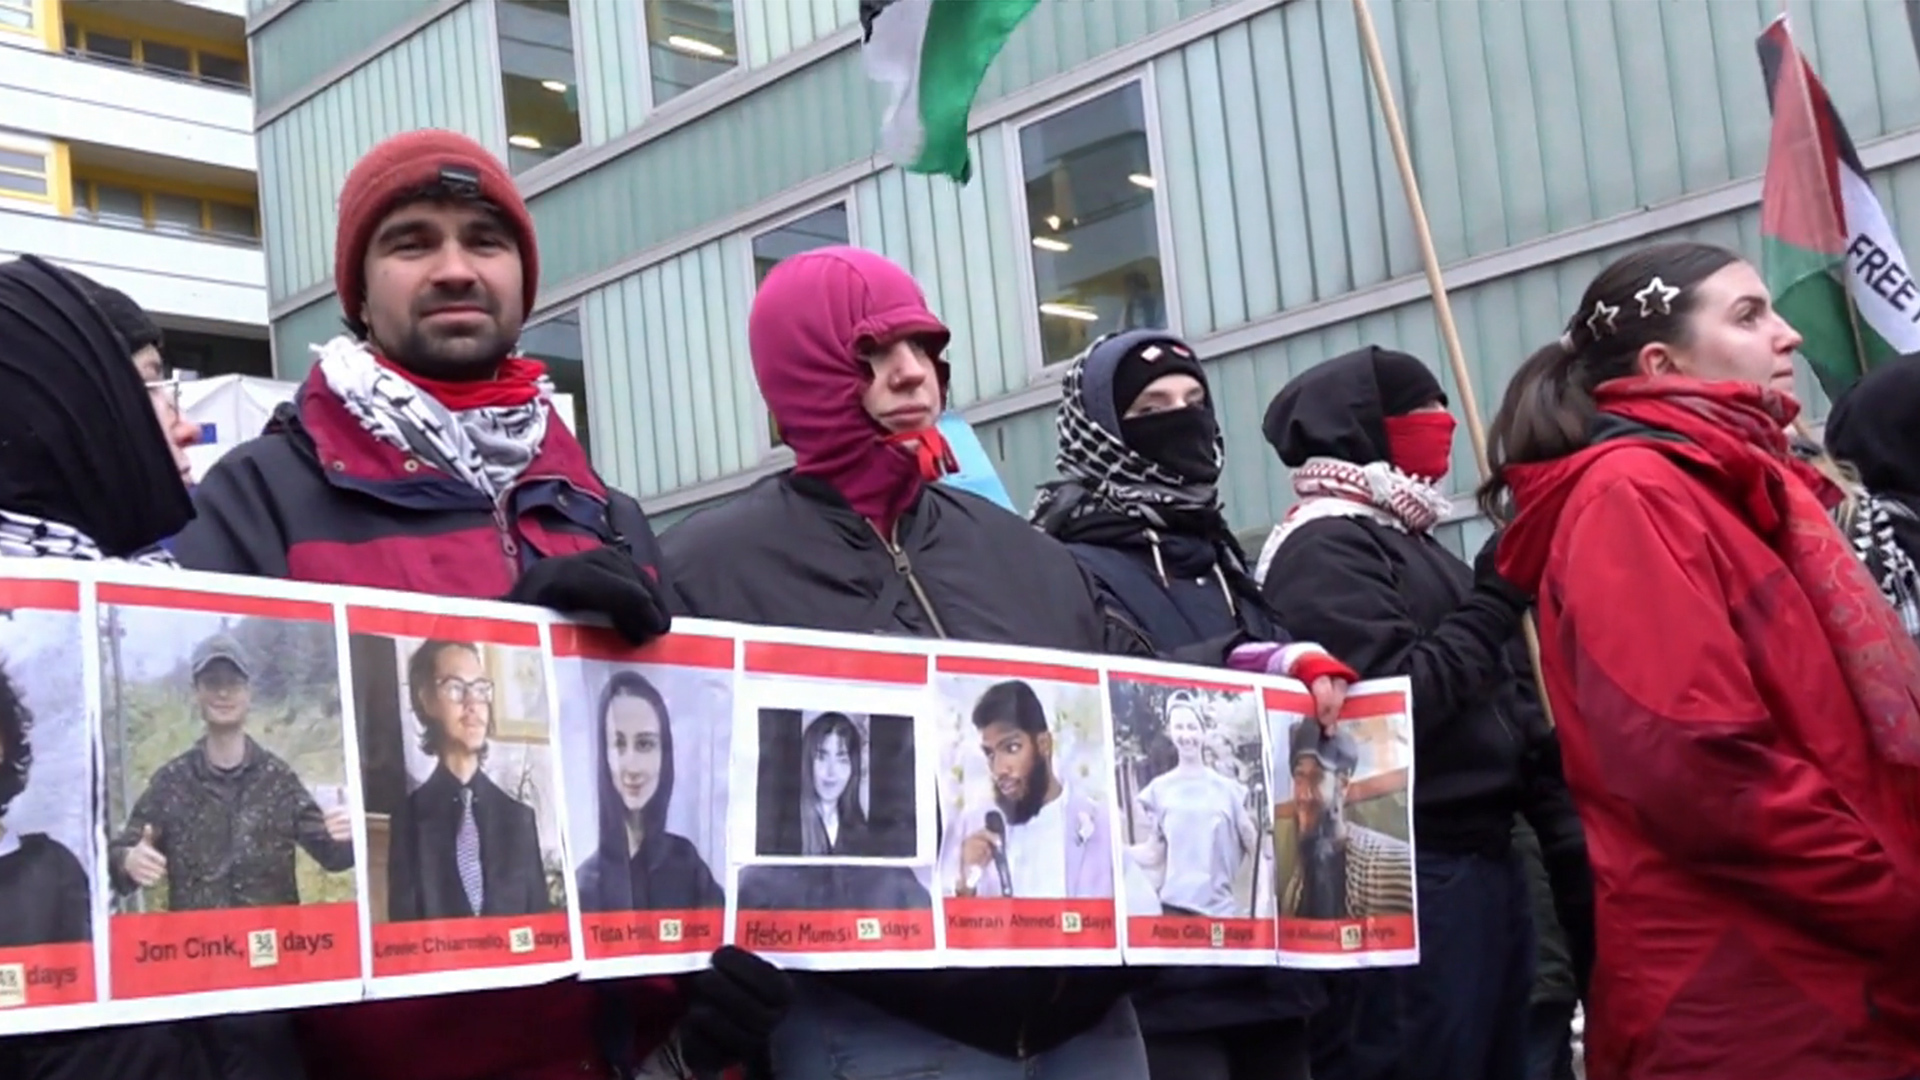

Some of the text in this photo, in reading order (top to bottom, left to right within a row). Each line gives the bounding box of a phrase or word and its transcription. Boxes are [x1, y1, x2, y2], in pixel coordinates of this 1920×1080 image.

[1848, 232, 1920, 312] FREE
[135, 939, 178, 963] Jon
[183, 933, 245, 959] Cink,
[282, 928, 335, 956] days
[882, 920, 921, 940] days
[26, 962, 78, 990] days
